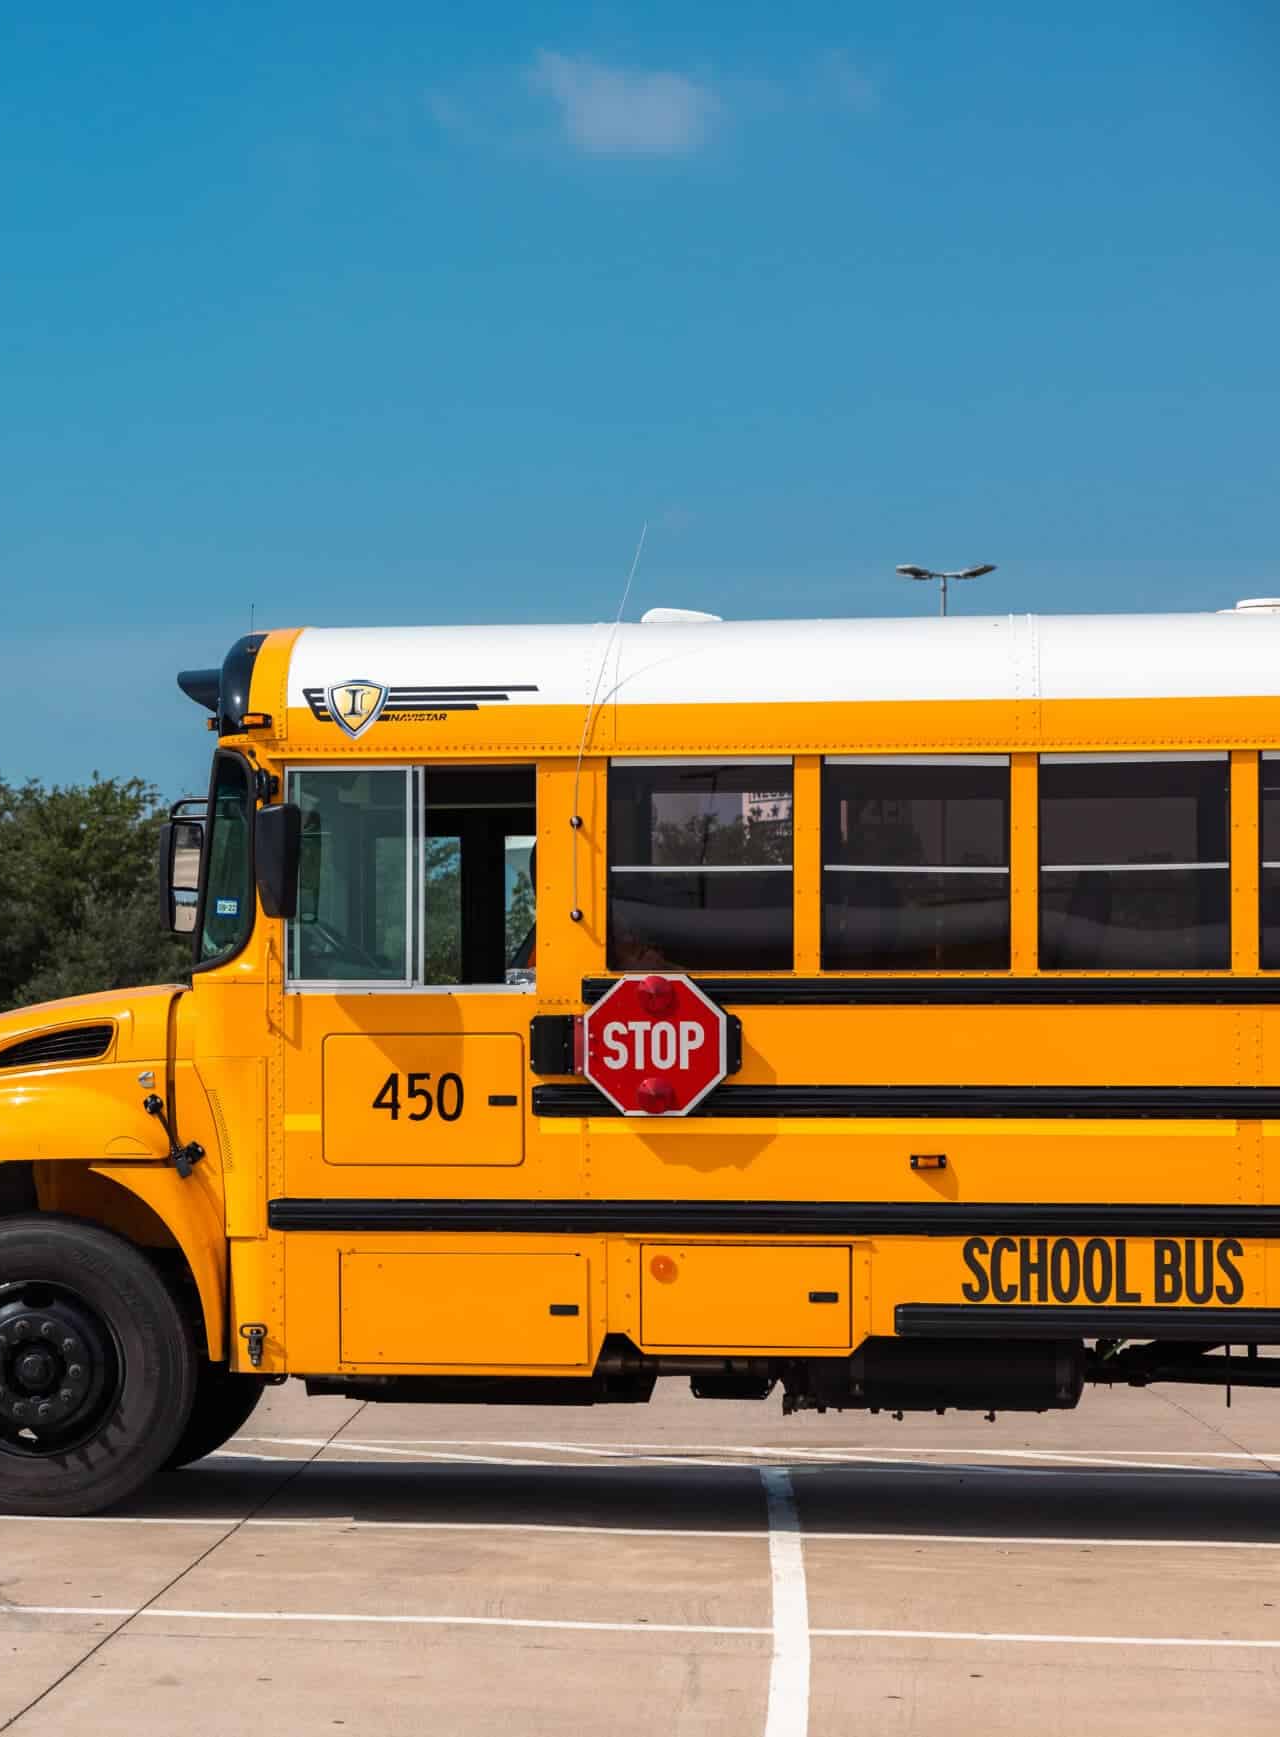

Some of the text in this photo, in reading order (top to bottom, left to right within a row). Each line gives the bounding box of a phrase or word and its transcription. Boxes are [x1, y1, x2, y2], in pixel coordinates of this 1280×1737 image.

[389, 713, 448, 721] NAVISTAR
[603, 1021, 705, 1070] STOP
[372, 1072, 464, 1121] 450
[961, 1237, 1245, 1304] SCHOOL BUS
